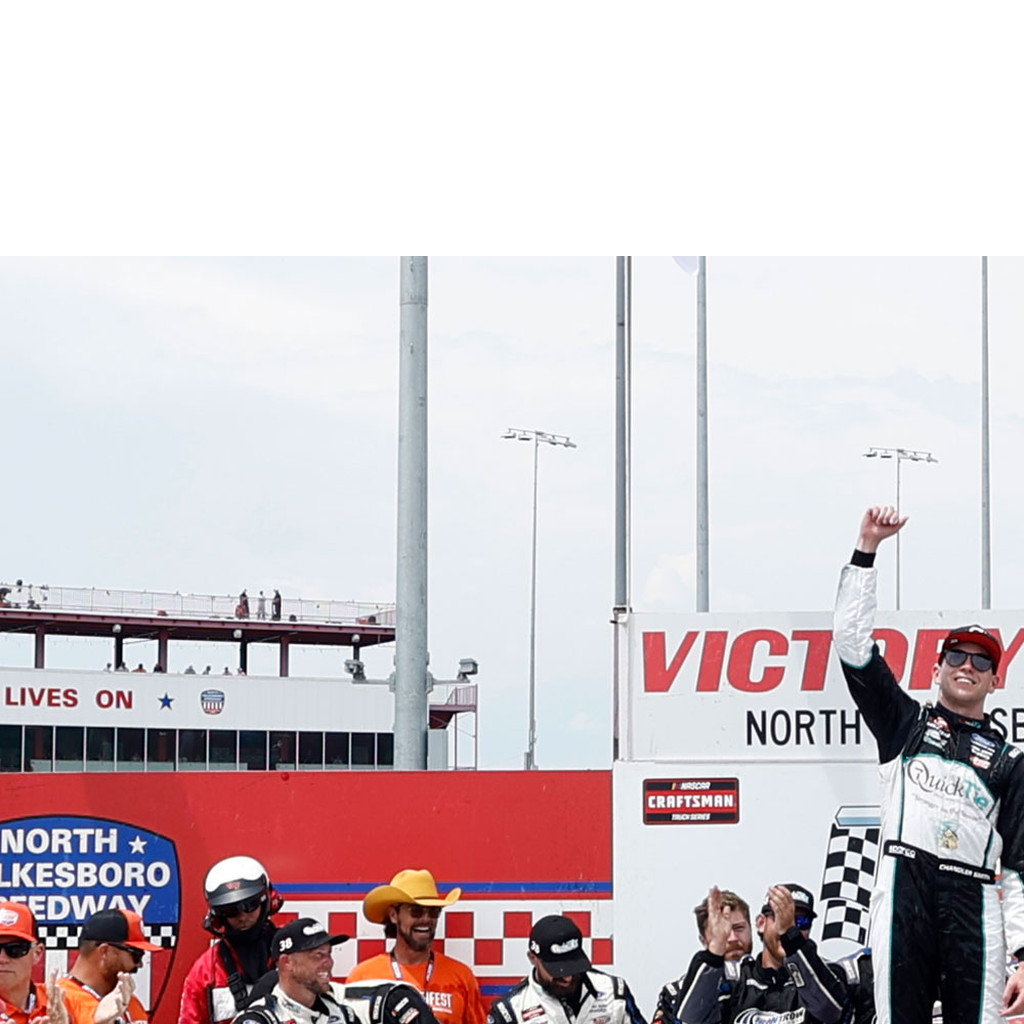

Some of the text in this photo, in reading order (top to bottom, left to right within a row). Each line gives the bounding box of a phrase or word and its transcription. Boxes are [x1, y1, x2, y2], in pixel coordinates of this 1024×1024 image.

[5, 687, 133, 709] LIVES ON
[746, 709, 862, 746] NORTH
[907, 759, 990, 811] QuickTie
[648, 795, 734, 808] CRAFTSMAN
[1, 829, 118, 854] NORTH
[939, 863, 973, 877] CHANDLER
[279, 937, 293, 952] 38
